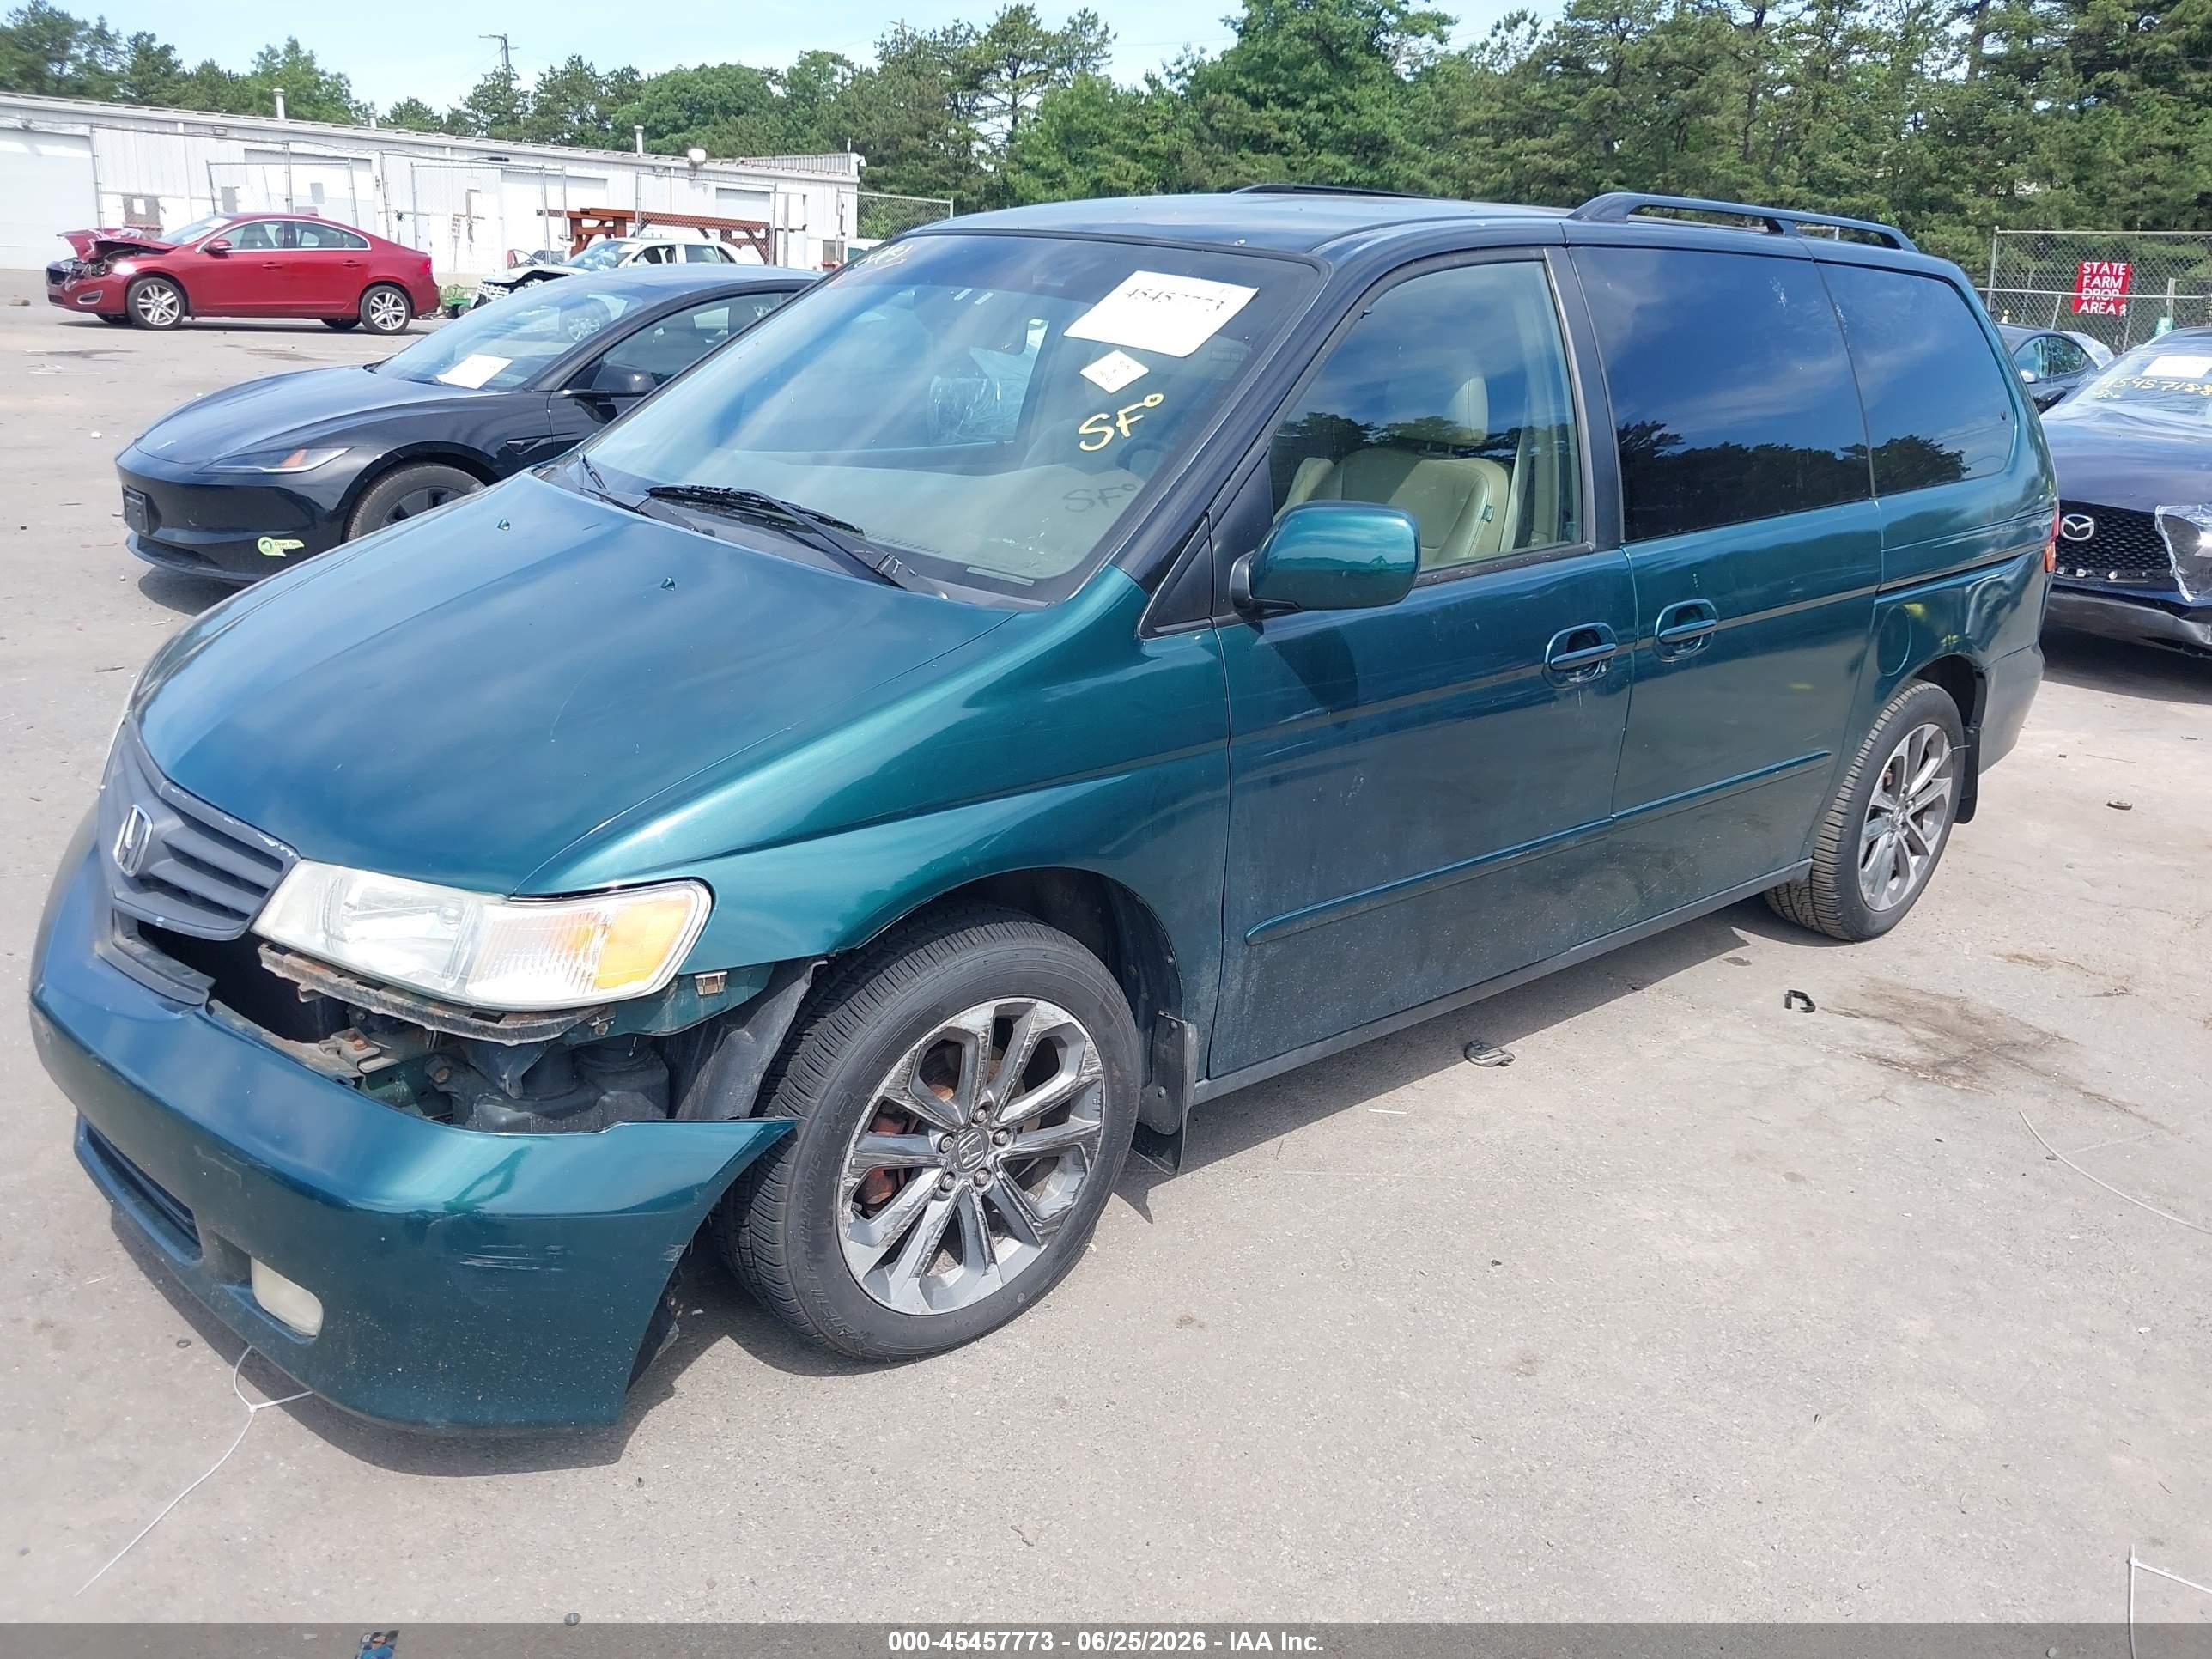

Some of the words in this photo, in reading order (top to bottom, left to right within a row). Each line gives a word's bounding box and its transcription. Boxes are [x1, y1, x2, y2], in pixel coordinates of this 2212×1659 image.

[2082, 261, 2128, 275] STATE
[2082, 275, 2124, 289] FARM
[2081, 288, 2120, 301] DROP
[2078, 301, 2117, 315] AREA
